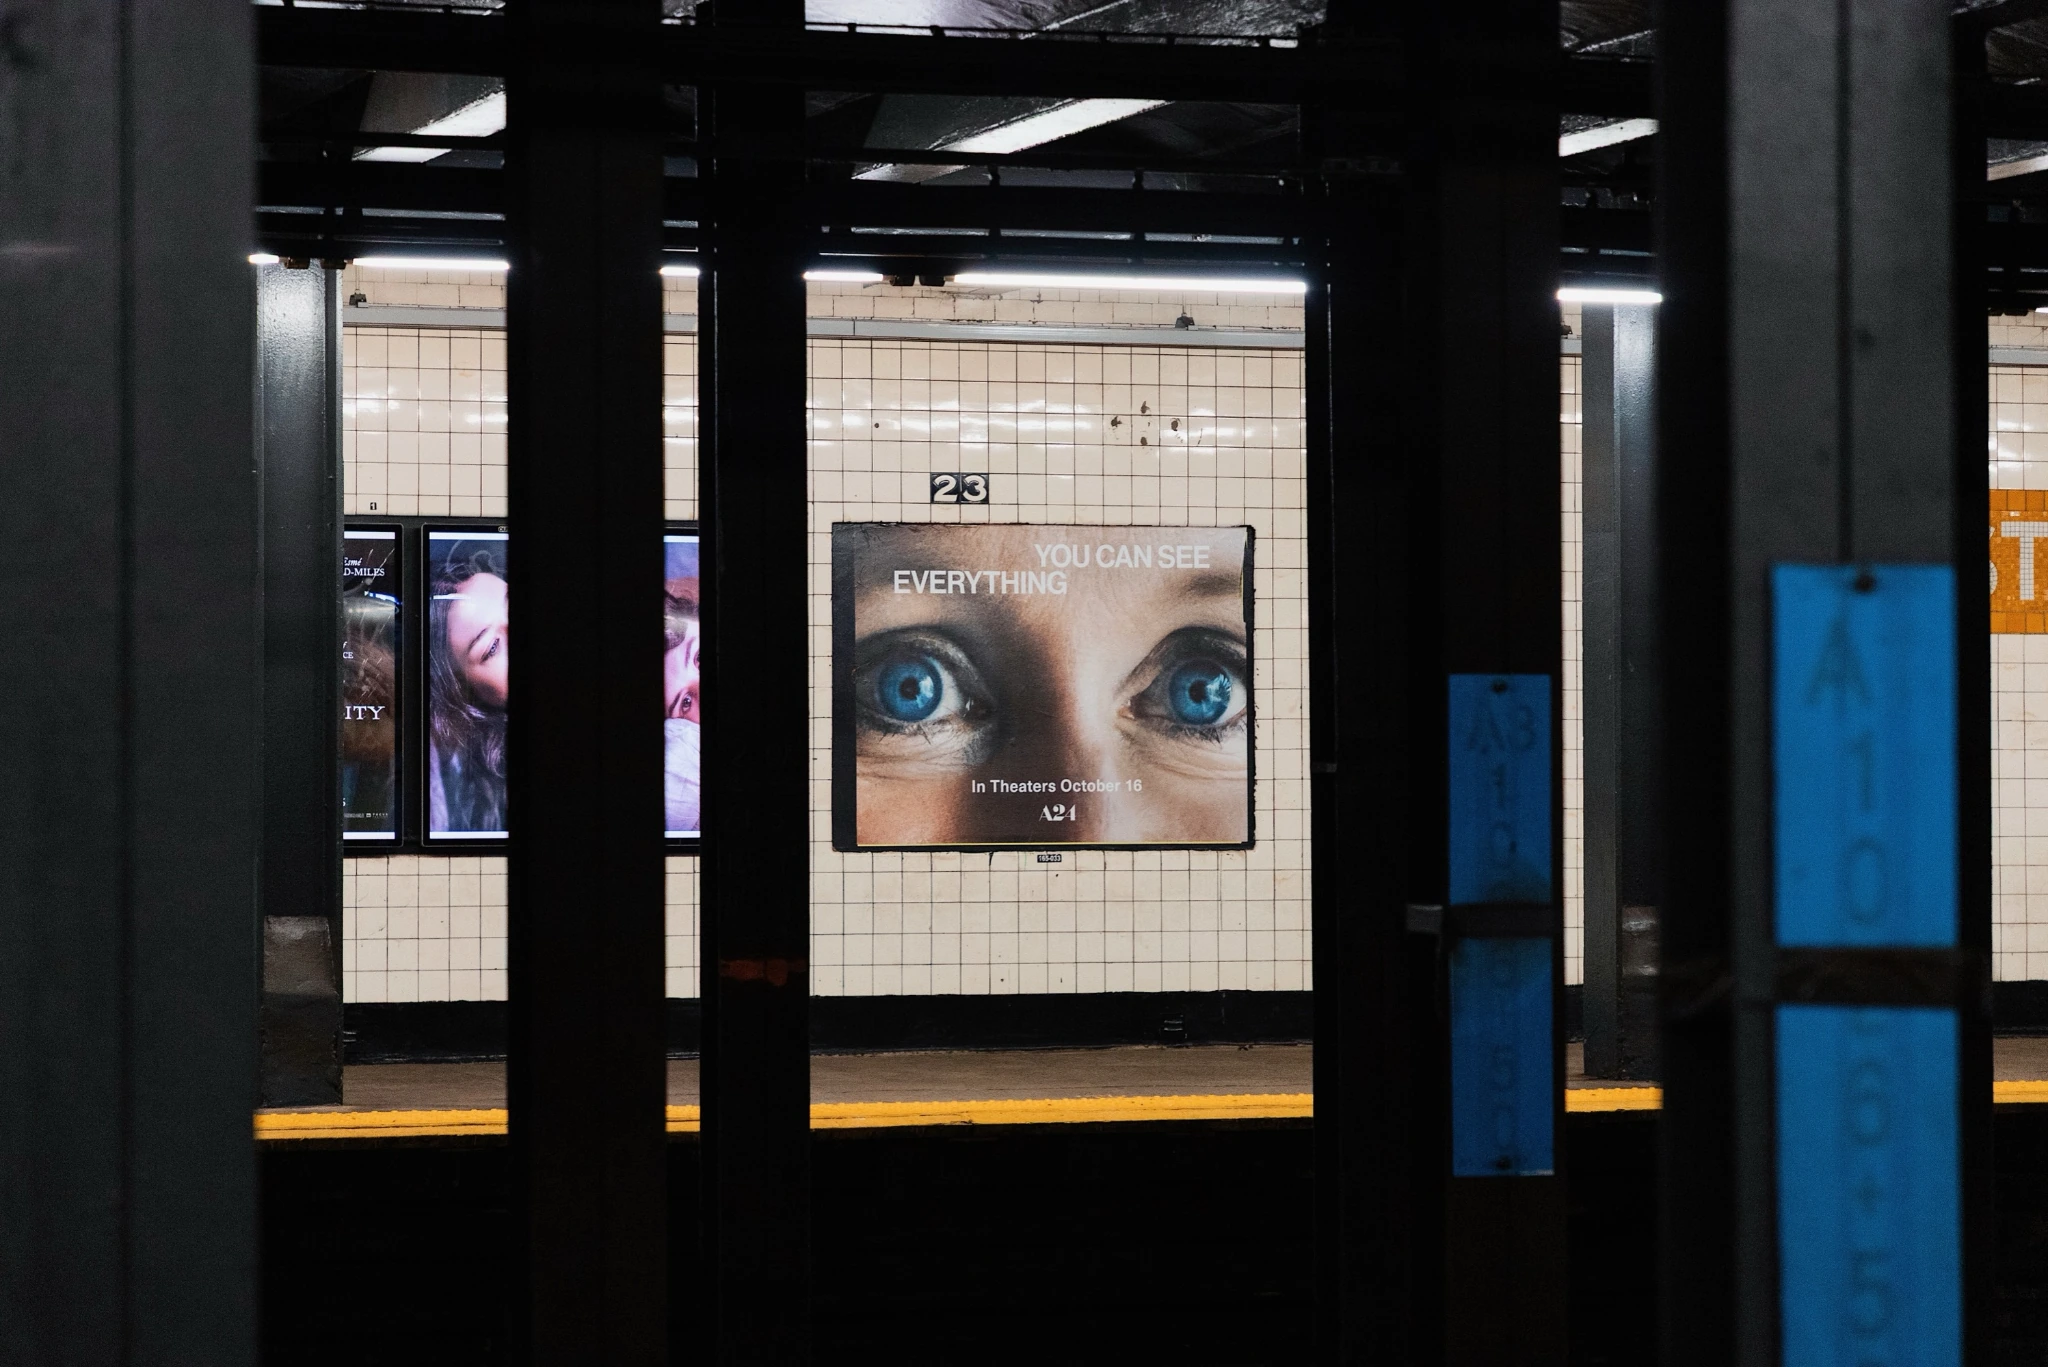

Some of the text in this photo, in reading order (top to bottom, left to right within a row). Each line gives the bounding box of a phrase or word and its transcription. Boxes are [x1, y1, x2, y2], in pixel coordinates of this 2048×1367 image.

[933, 475, 988, 502] 23
[1034, 543, 1211, 569] YOU CAN SEE
[1989, 520, 2048, 601] T
[893, 569, 1068, 595] EVERYTHING
[343, 705, 386, 720] ITY
[971, 778, 1143, 793] In Theaters October 16
[1039, 803, 1076, 822] A24
